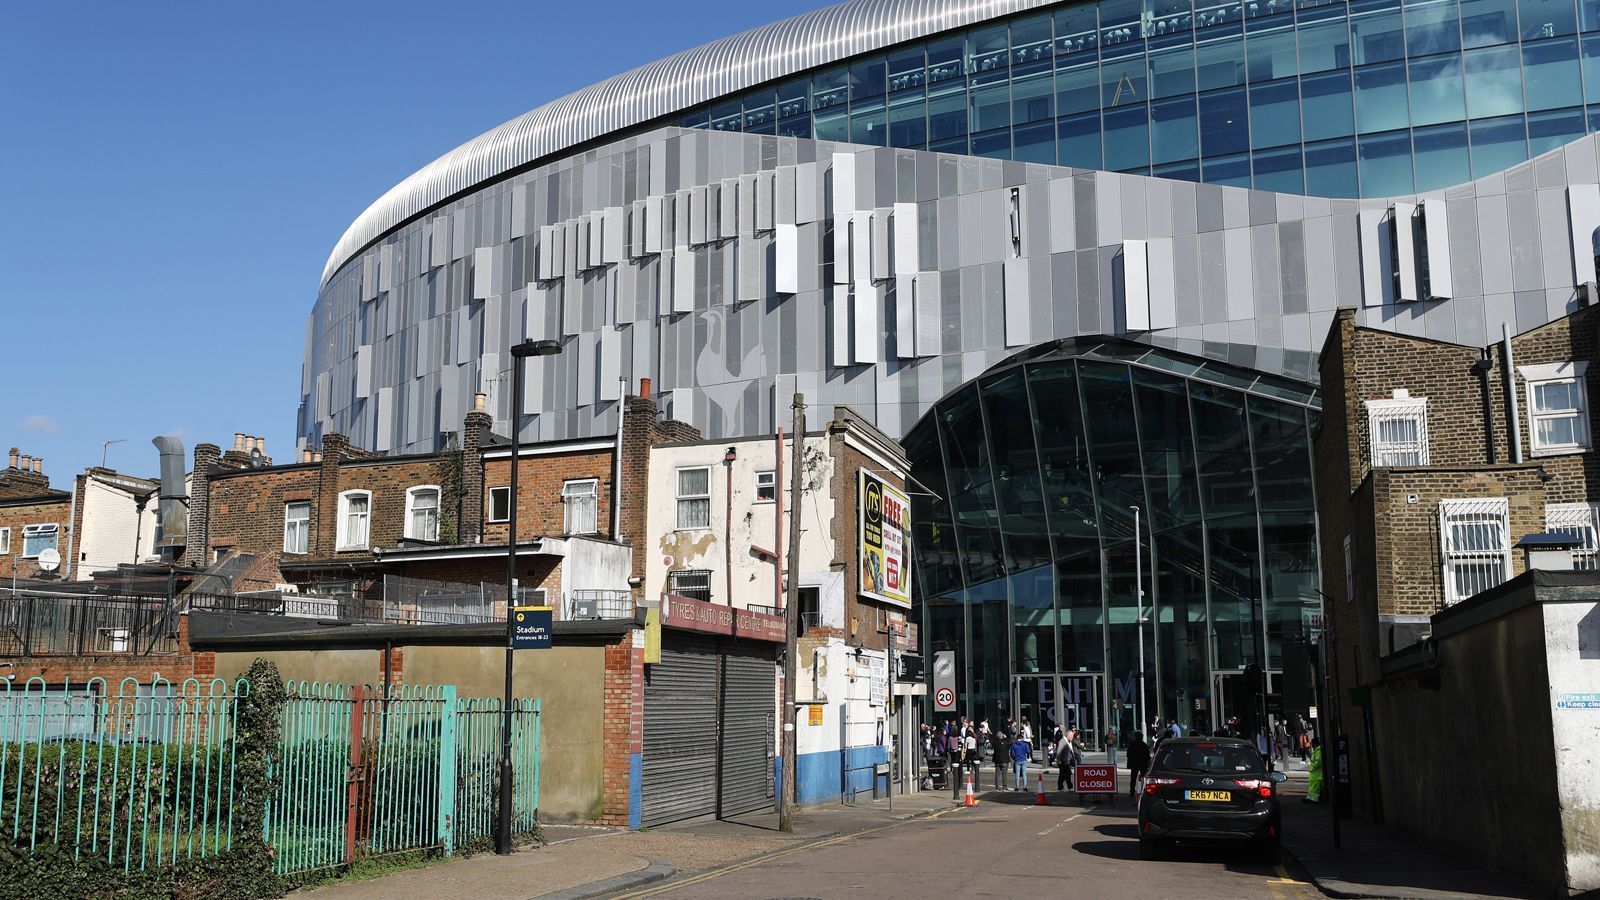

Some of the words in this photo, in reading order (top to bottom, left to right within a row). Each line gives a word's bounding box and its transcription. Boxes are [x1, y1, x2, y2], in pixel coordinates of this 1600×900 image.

[671, 601, 695, 621] TYRES
[700, 608, 717, 626] AUTO
[939, 693, 952, 702] 20
[1083, 769, 1108, 777] ROAD
[1079, 780, 1113, 788] CLOSED
[1190, 790, 1211, 799] EK67
[1213, 791, 1230, 800] NCA
